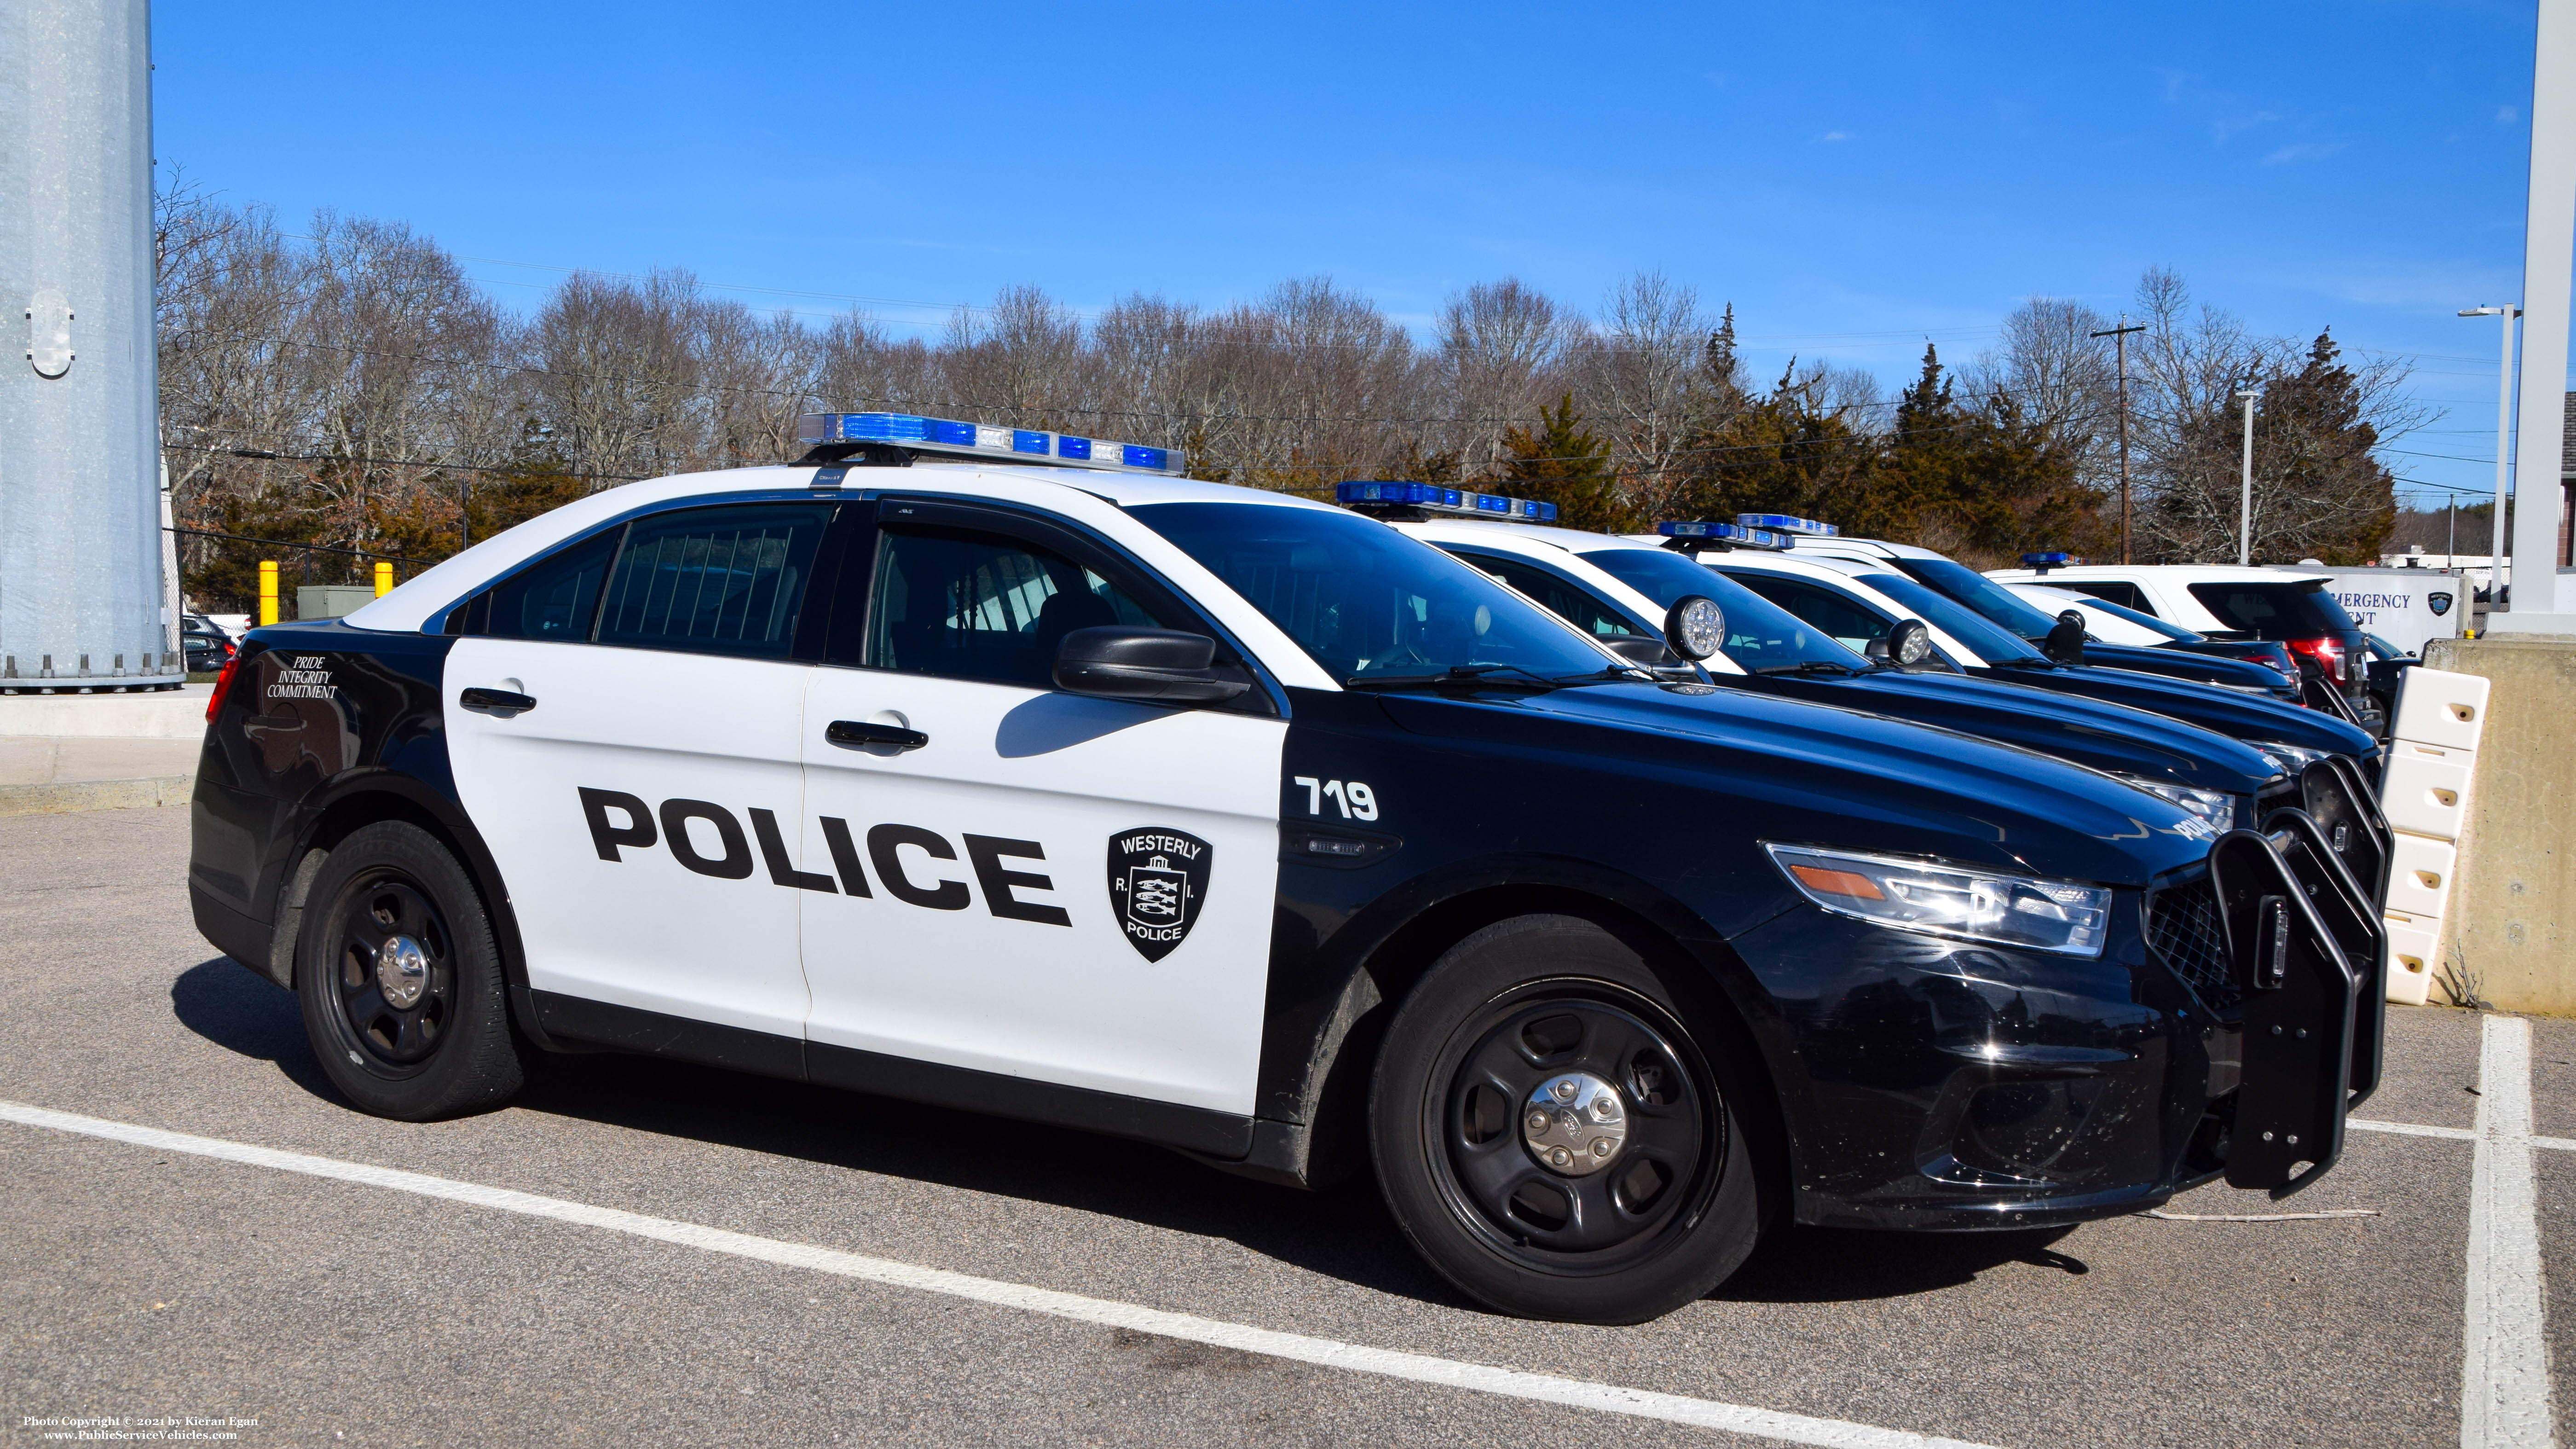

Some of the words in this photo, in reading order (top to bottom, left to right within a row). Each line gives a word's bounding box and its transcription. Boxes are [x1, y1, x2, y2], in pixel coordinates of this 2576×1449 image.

[2330, 593, 2410, 608] MERGENCY
[293, 656, 325, 669] PRIDE
[278, 671, 332, 684] INTEGRITY
[267, 684, 338, 699] COMMITMENT
[1294, 776, 1378, 821] 719
[1121, 835, 1201, 860] WESTERLY
[577, 786, 1073, 927] POLICE
[1115, 877, 1127, 891] R.
[1127, 921, 1182, 941] POLICE
